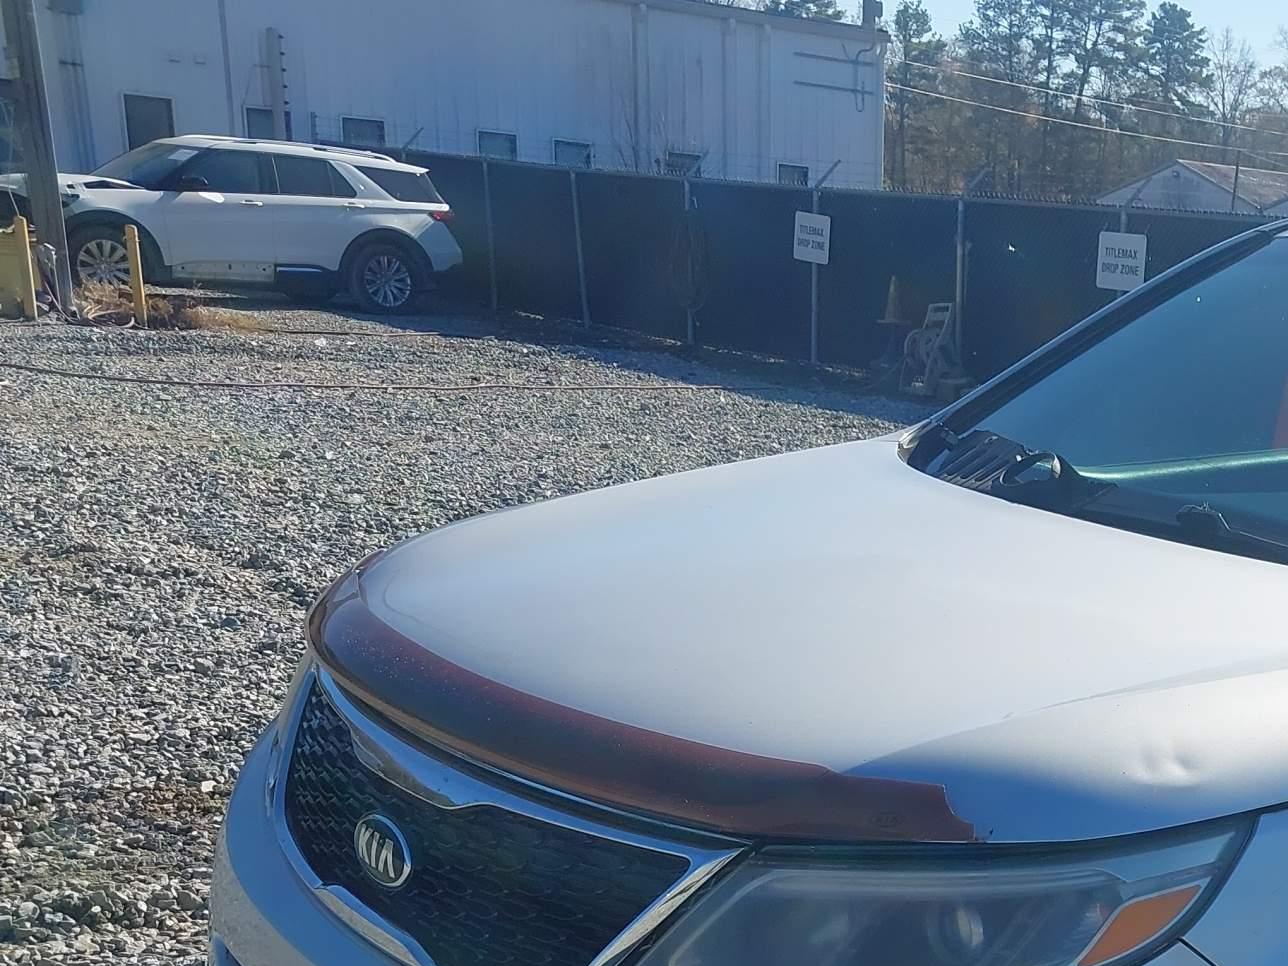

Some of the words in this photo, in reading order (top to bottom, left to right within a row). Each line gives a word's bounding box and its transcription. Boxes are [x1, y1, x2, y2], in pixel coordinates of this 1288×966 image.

[1104, 247, 1138, 259] TITLEMAX
[1101, 261, 1118, 274] DROP
[1120, 264, 1140, 277] ZONE
[358, 823, 395, 879] KIA
